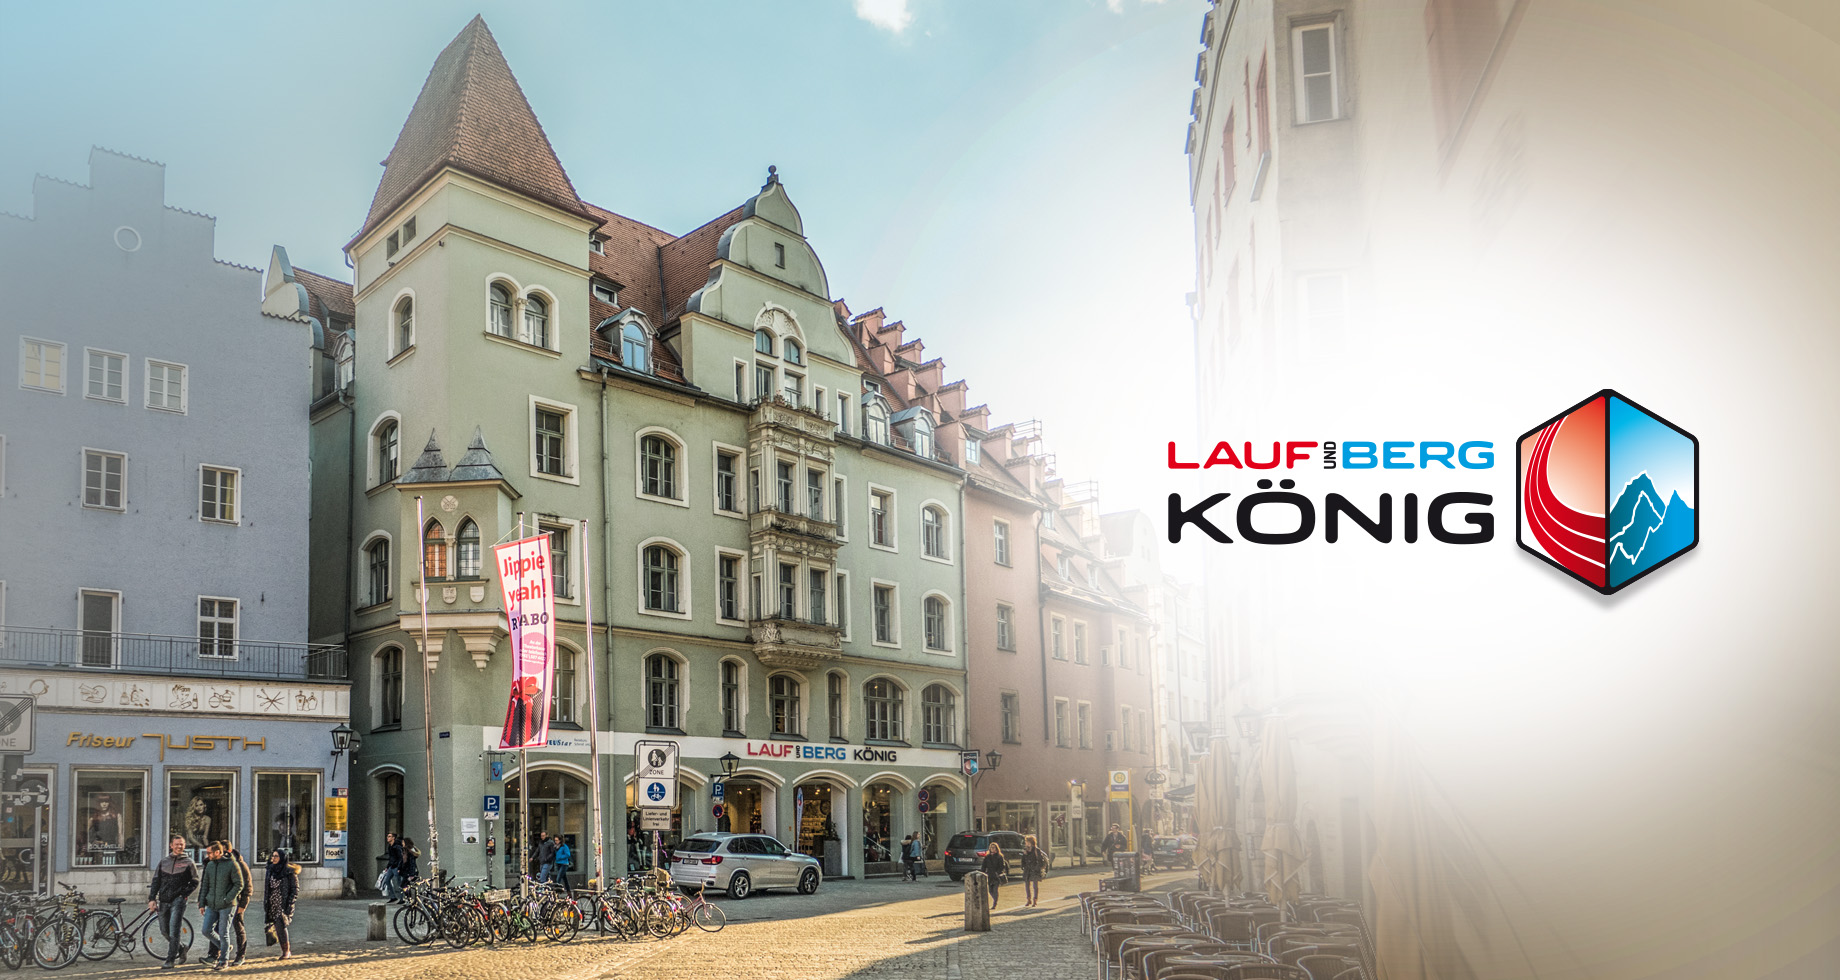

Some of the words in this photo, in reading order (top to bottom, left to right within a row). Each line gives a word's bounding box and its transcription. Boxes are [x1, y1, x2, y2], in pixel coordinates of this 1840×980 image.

[504, 550, 545, 580] Jippie
[508, 578, 547, 612] yeah!
[66, 731, 136, 749] Friseur
[747, 742, 794, 758] LAUF
[802, 745, 846, 761] BERG
[853, 747, 897, 762] KÖNIG
[715, 784, 722, 795] P
[487, 797, 497, 809] P
